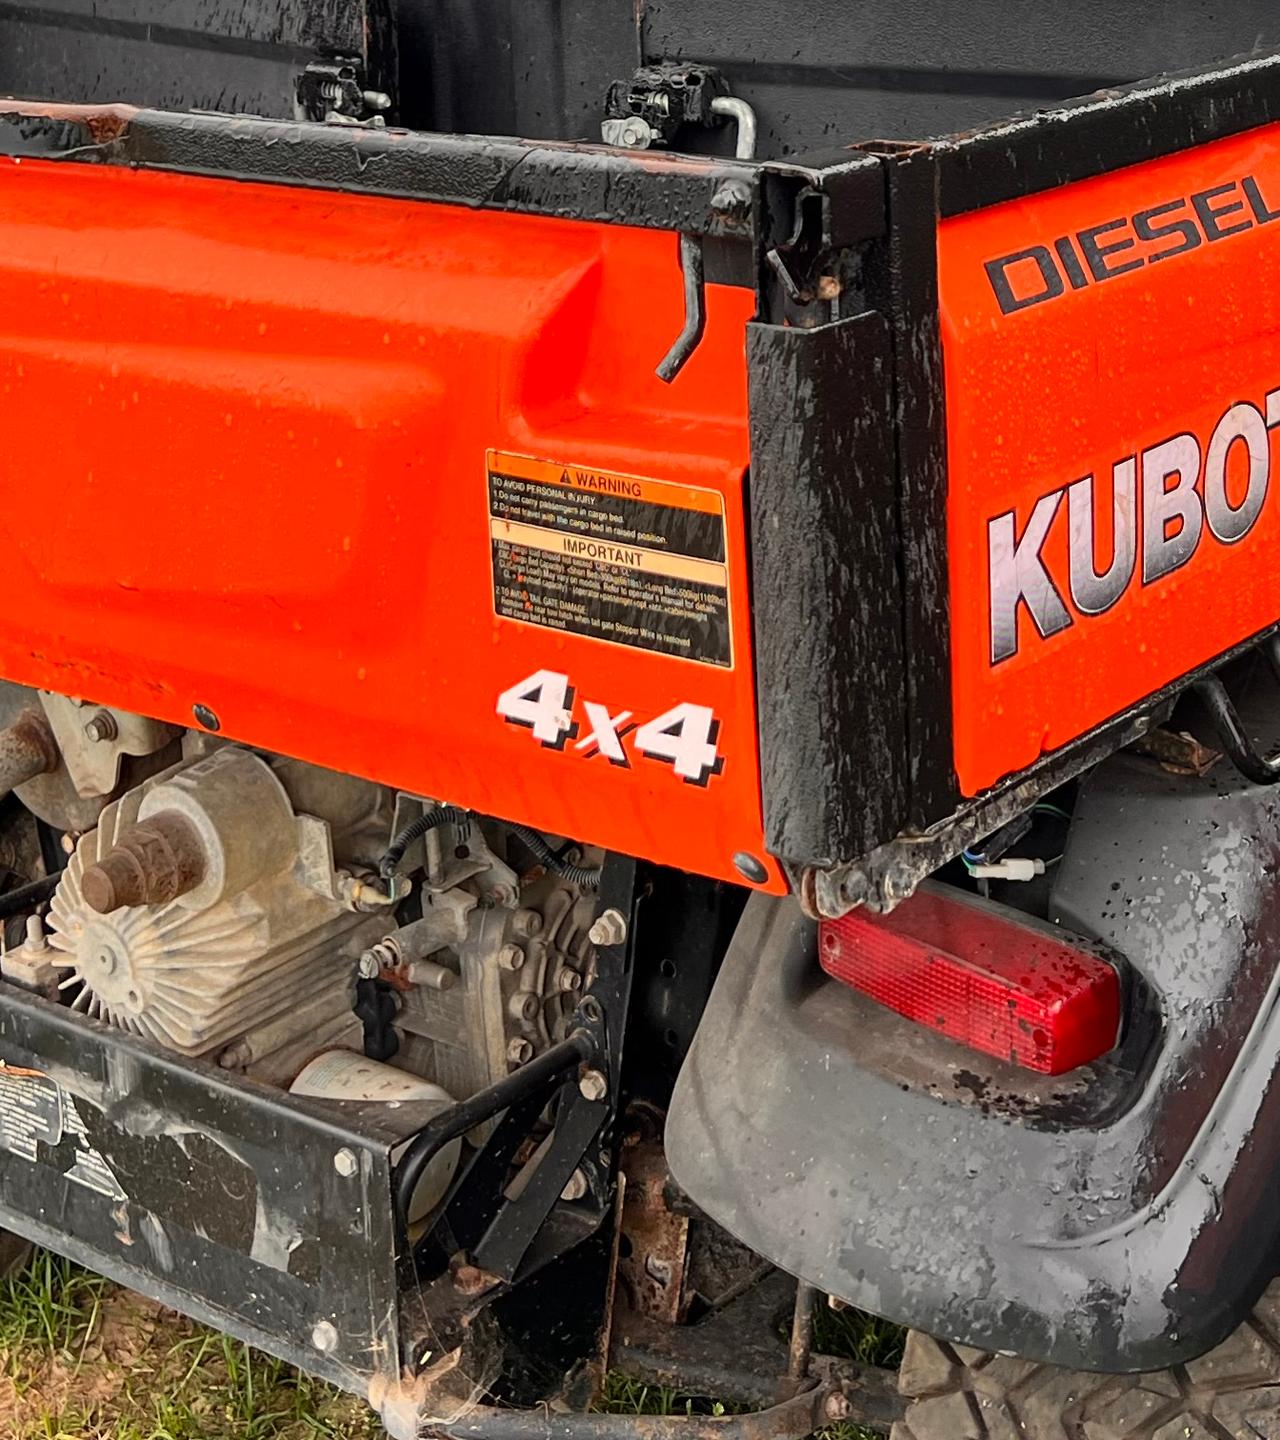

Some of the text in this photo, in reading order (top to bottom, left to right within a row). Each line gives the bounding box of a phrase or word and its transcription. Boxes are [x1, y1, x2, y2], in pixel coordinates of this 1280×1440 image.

[492, 478, 502, 486] TO
[503, 480, 524, 491] AVOID
[526, 484, 565, 499] PERSONAL
[576, 473, 641, 496] WARNING
[509, 494, 520, 502] not
[521, 496, 537, 505] carry
[587, 509, 607, 519] cargo
[510, 506, 520, 515] not
[556, 515, 568, 524] the
[569, 518, 588, 528] cargo
[590, 522, 603, 531] bed
[605, 525, 612, 533] in
[613, 526, 635, 538] raised
[563, 539, 643, 566] IMPORTANT
